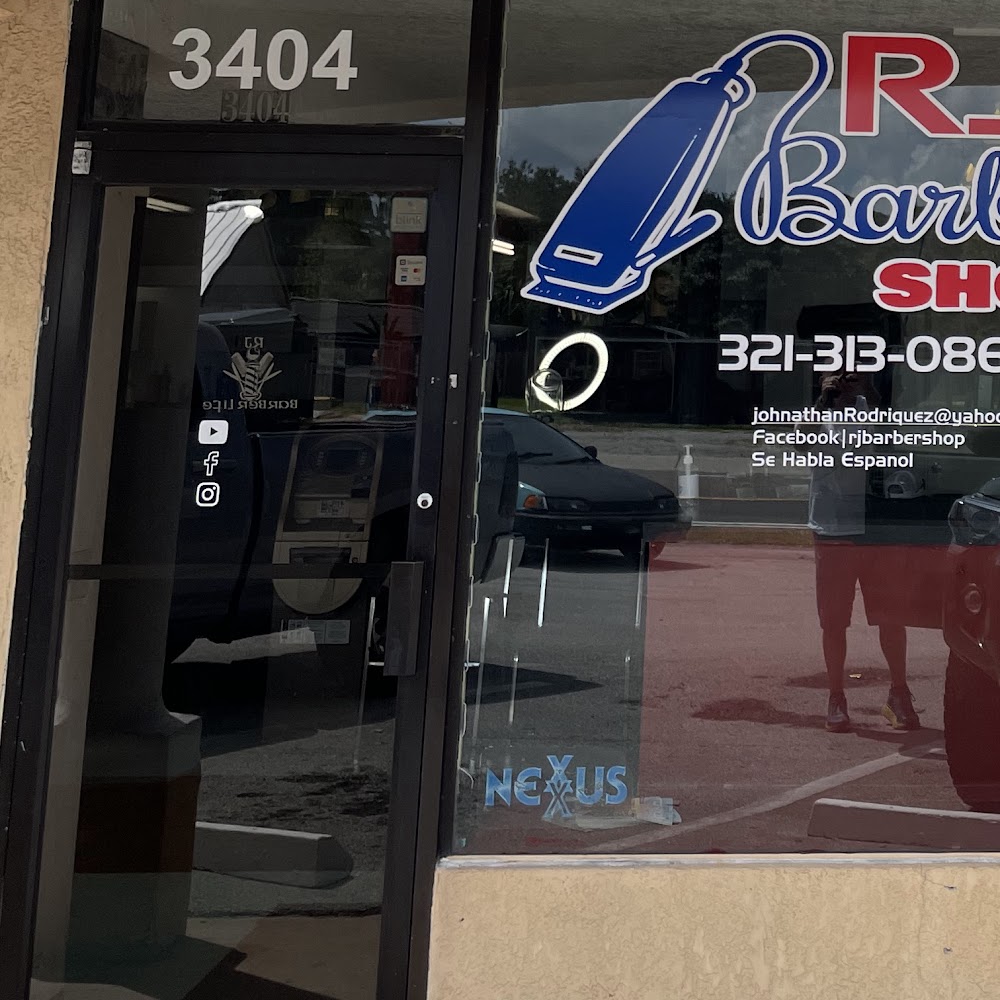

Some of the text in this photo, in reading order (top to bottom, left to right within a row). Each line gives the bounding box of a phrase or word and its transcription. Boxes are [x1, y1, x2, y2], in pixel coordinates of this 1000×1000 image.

[168, 27, 358, 91] 3404
[751, 452, 914, 470] Se Habla Espanol
